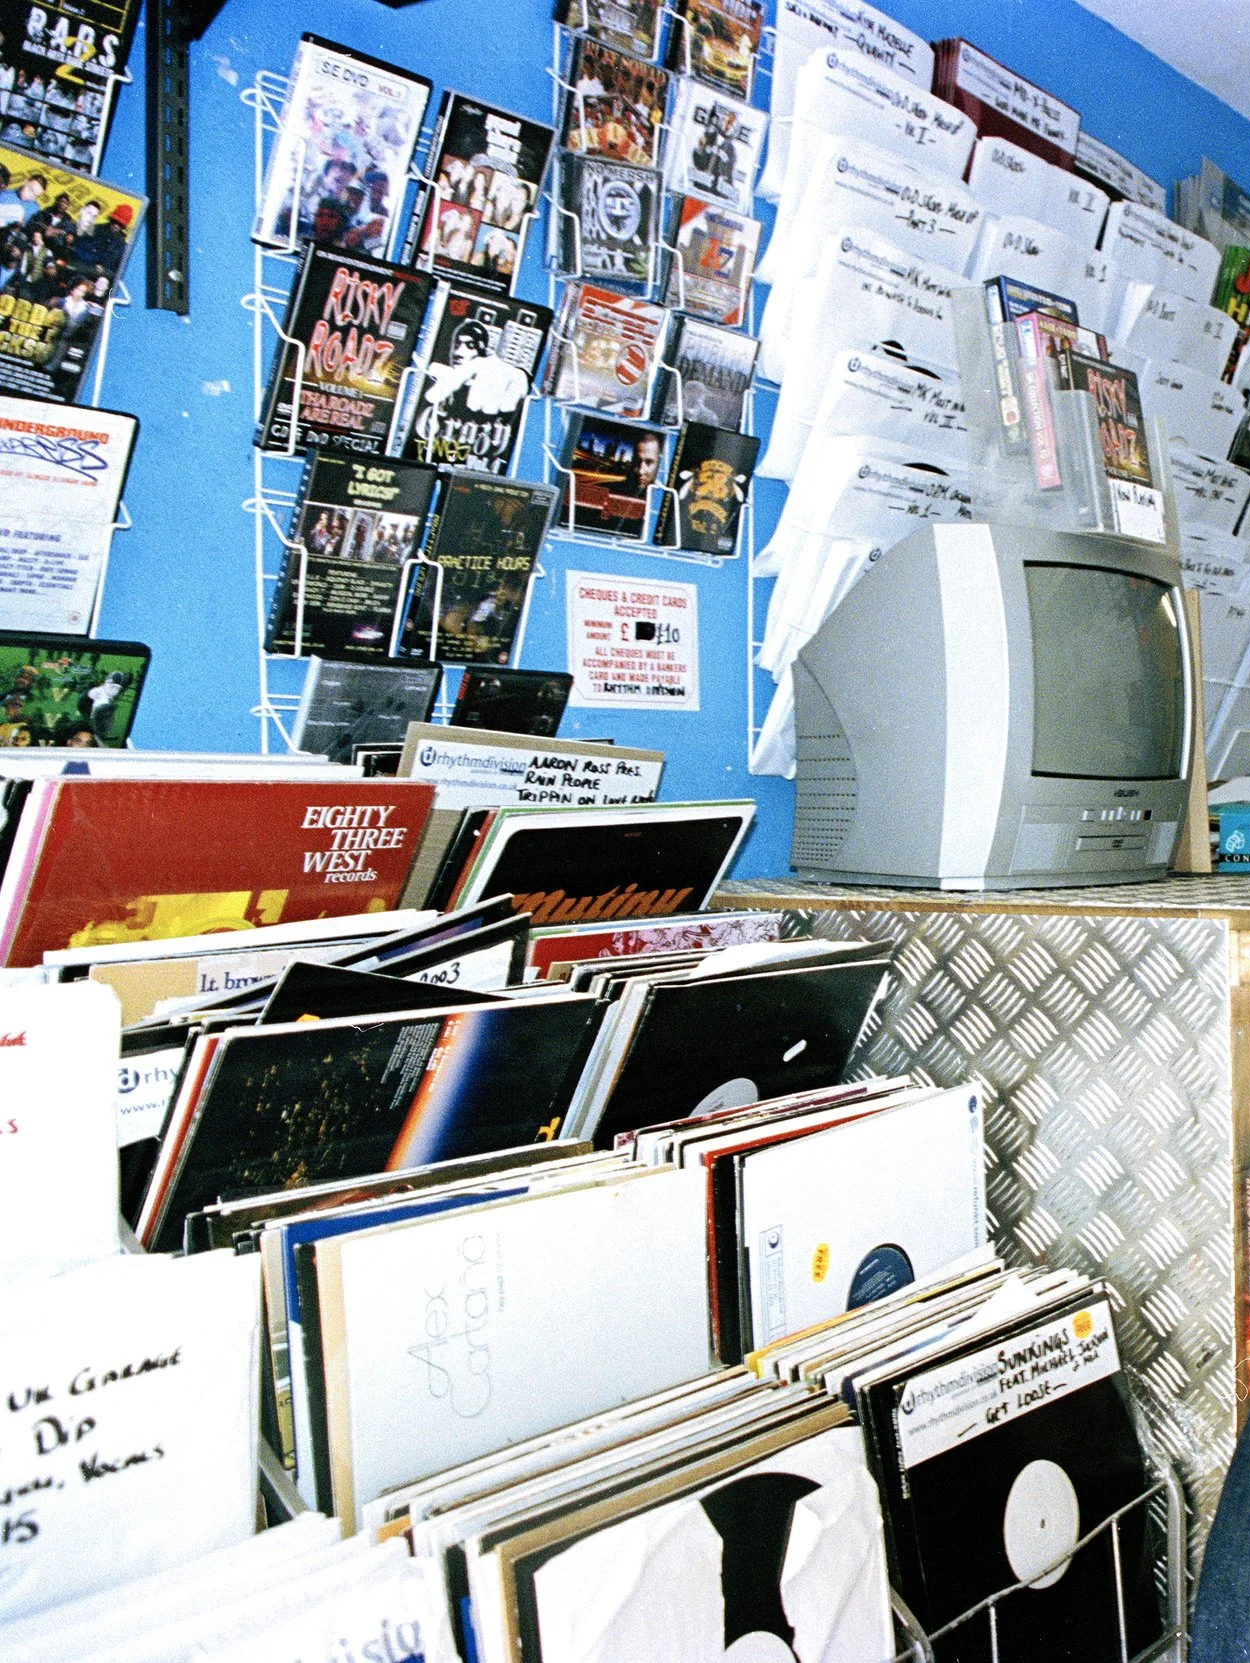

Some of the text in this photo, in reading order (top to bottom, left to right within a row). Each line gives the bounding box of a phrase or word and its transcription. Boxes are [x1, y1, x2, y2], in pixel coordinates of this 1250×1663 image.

[323, 267, 405, 335] RISKY
[304, 320, 394, 384] ROADZ
[0, 418, 109, 444] NDERGROUND
[416, 410, 512, 456] Crazy
[332, 433, 380, 454] SPECIAL
[437, 555, 531, 570] PRACTICE HOURS
[579, 587, 687, 608] CHEQUES & CREDIT CARDS
[614, 605, 657, 619] ACCEPTED
[621, 623, 629, 641] £
[595, 646, 608, 656] ALL
[611, 648, 643, 659] CHEQUES
[437, 752, 527, 772] rhythmdivision
[528, 755, 578, 772] AARON
[562, 774, 601, 790] PEOPLE
[301, 805, 397, 828] EIGHTY
[329, 828, 408, 850] THREE
[303, 850, 372, 873] WEST
[324, 868, 378, 883] records
[998, 1327, 1070, 1374] SUNKINGS
[985, 1380, 1053, 1424] GET LOOSE
